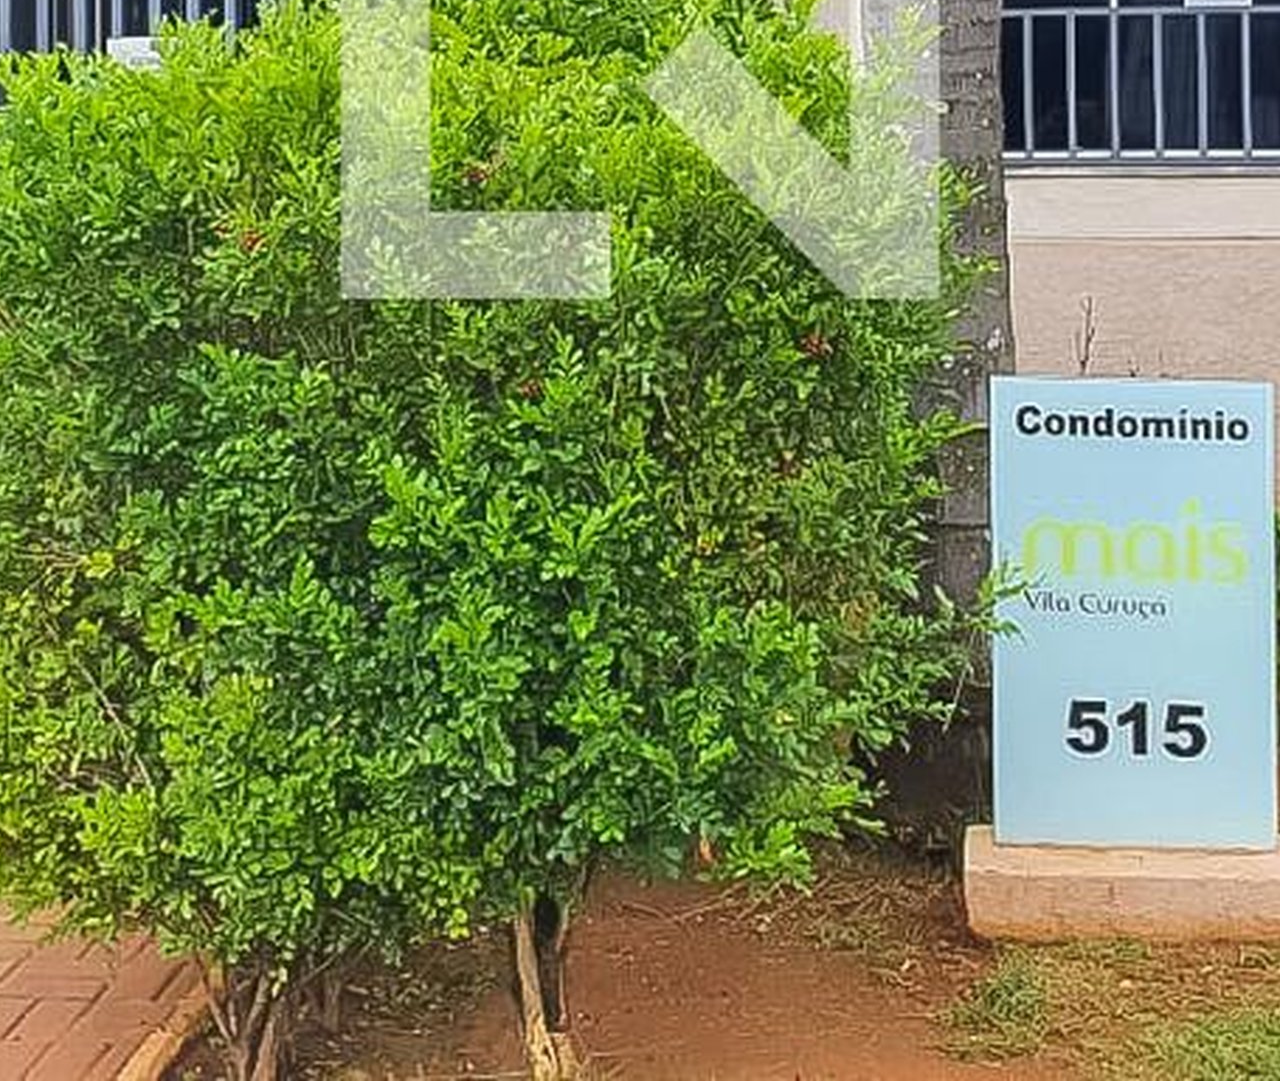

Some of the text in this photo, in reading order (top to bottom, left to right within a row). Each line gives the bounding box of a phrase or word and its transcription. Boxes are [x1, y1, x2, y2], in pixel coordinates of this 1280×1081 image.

[1014, 404, 1250, 442] Condomínio
[1022, 495, 1247, 586] mais
[1023, 588, 1070, 615] Vila
[1065, 699, 1209, 758] 515
